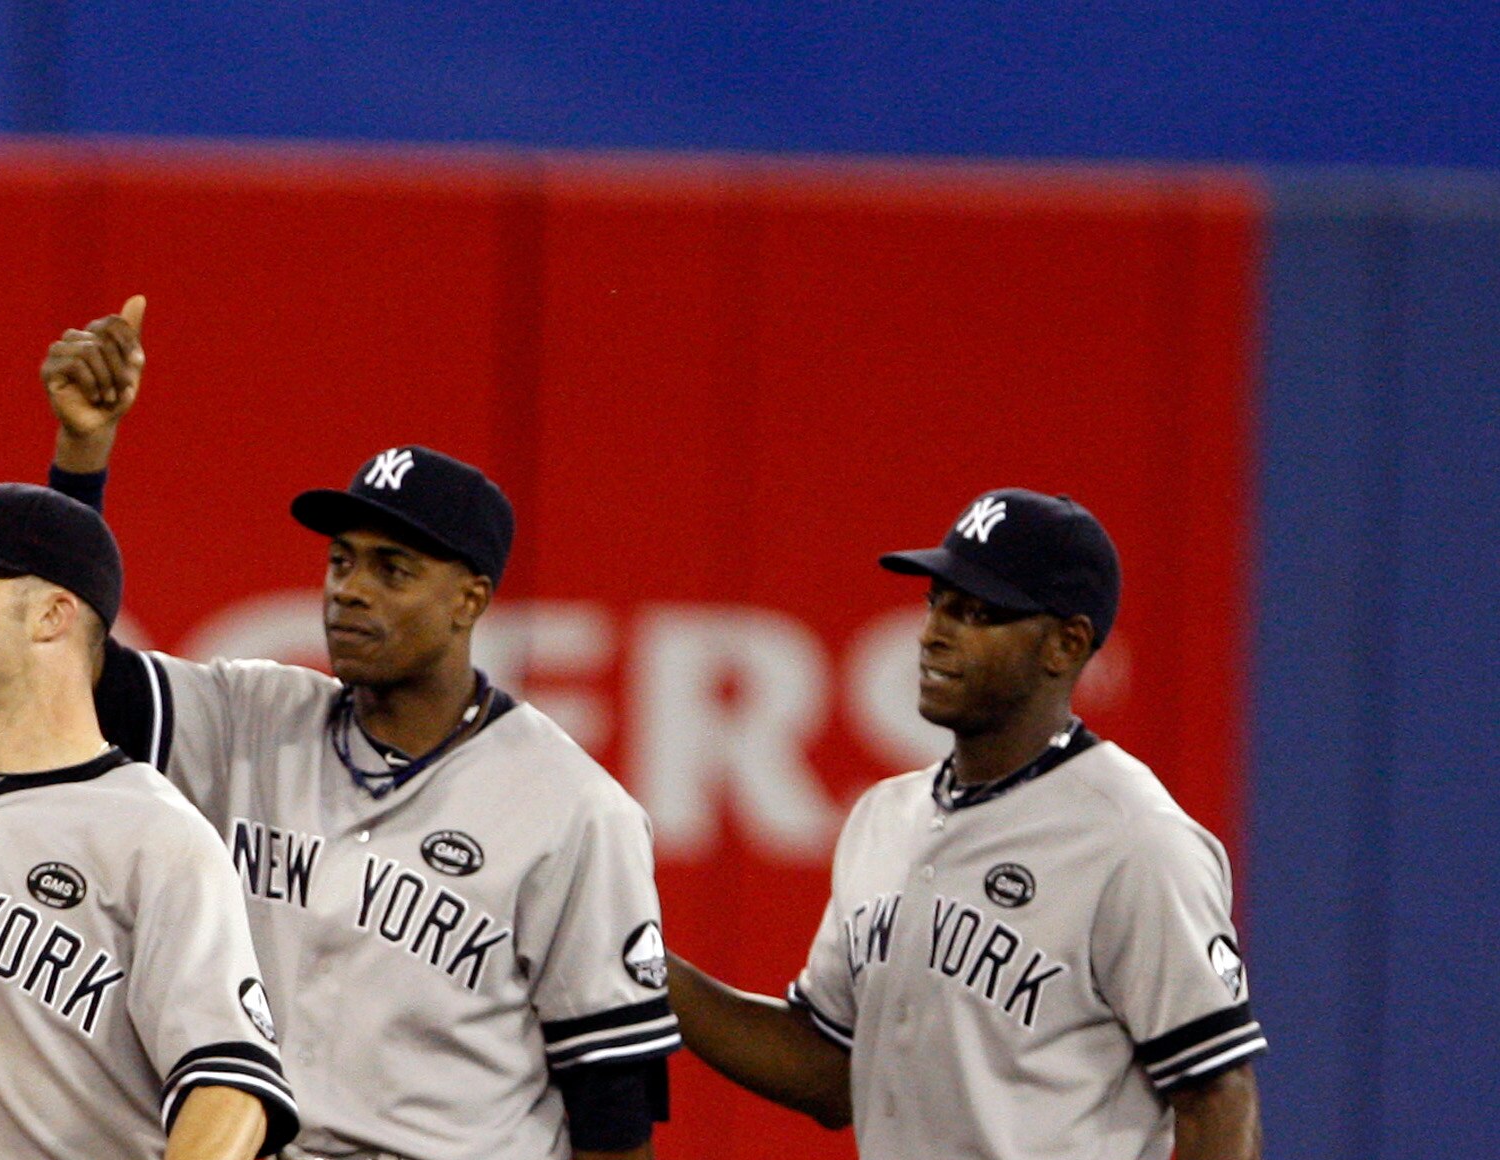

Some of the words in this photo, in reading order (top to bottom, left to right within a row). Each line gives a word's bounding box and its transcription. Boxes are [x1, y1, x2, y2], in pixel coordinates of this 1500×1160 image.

[364, 449, 414, 490] NY
[956, 496, 1007, 544] NY
[40, 874, 74, 897] GMS
[232, 817, 325, 909] NEW
[355, 852, 510, 992] YORK
[928, 896, 1069, 1030] YORK
